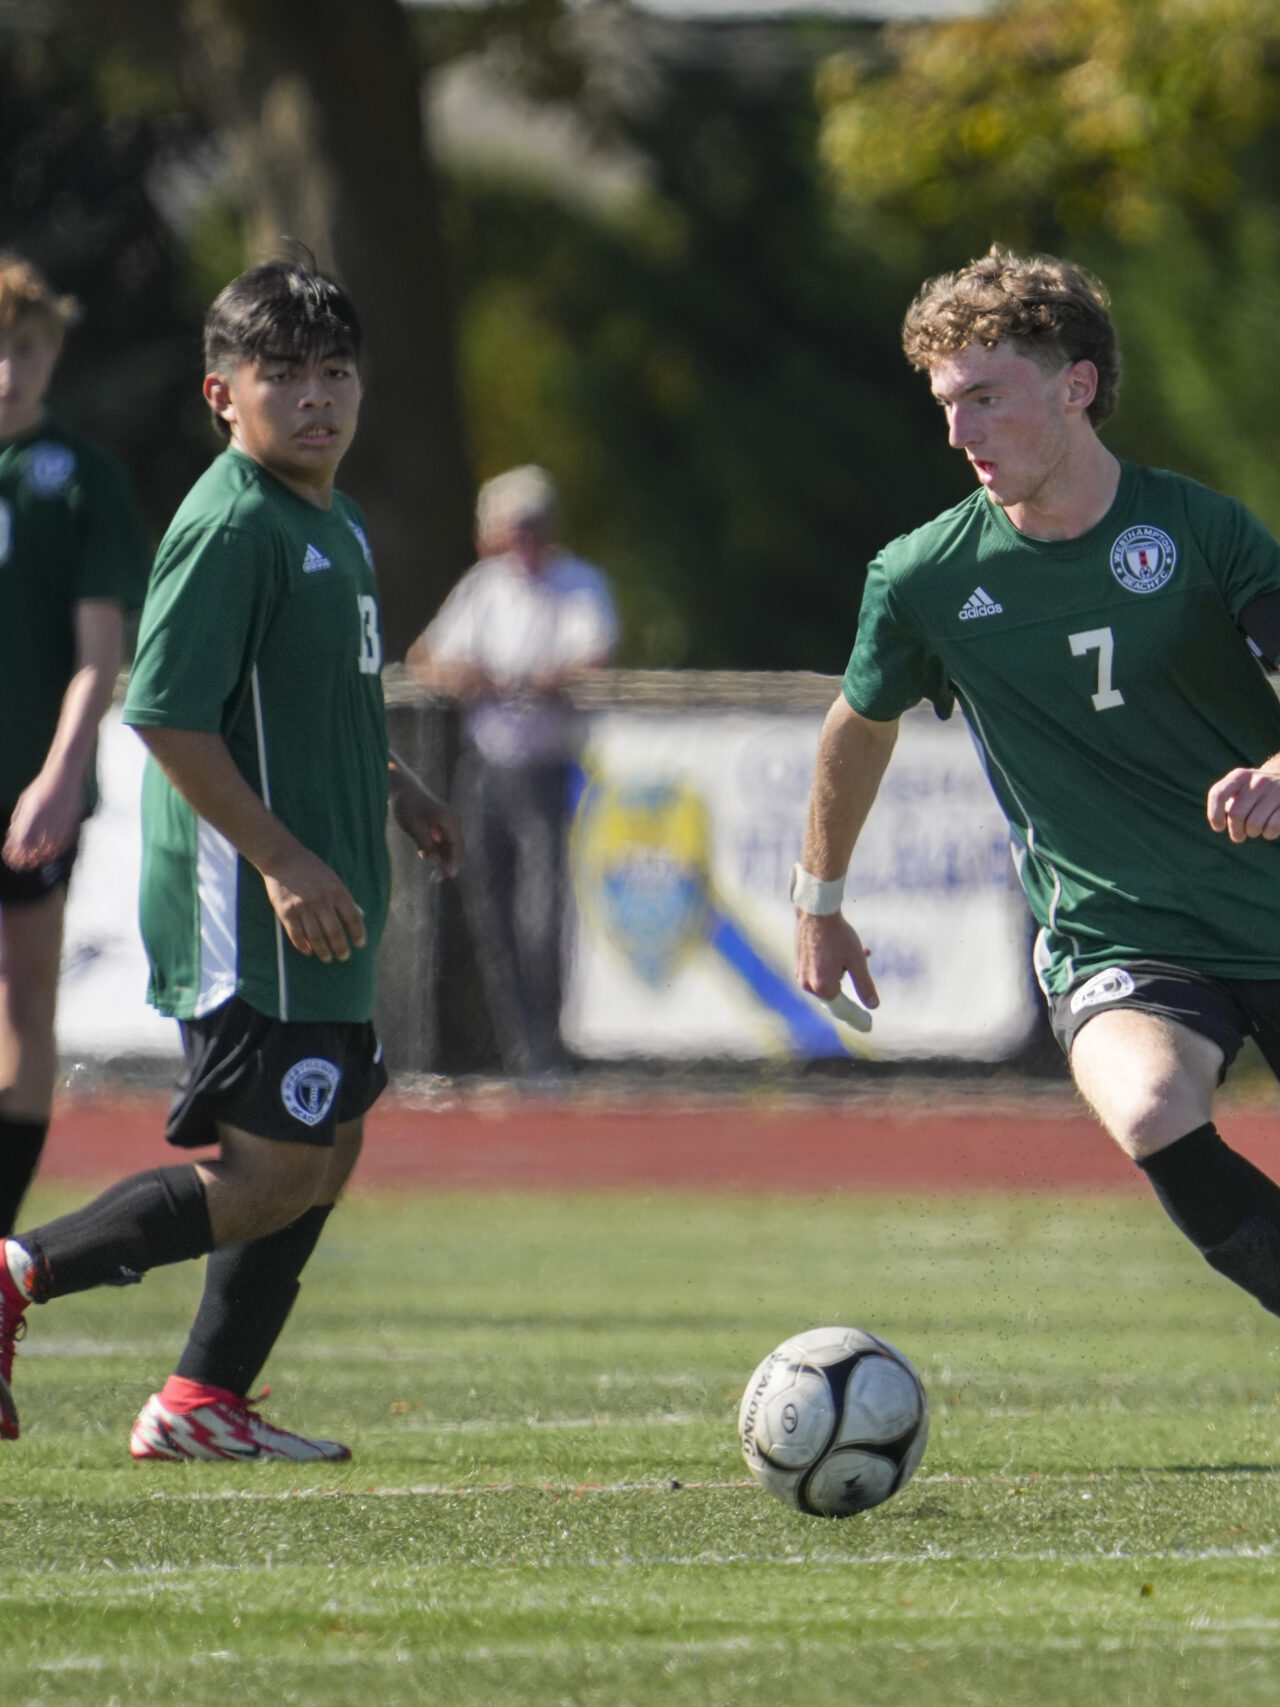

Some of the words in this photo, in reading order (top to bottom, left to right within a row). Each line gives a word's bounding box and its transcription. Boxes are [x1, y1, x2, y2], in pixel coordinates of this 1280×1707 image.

[1113, 528, 1172, 563] WESTHAMPTON
[1122, 575, 1155, 591] BEACH
[958, 603, 1003, 620] adidas
[1068, 626, 1125, 711] 7
